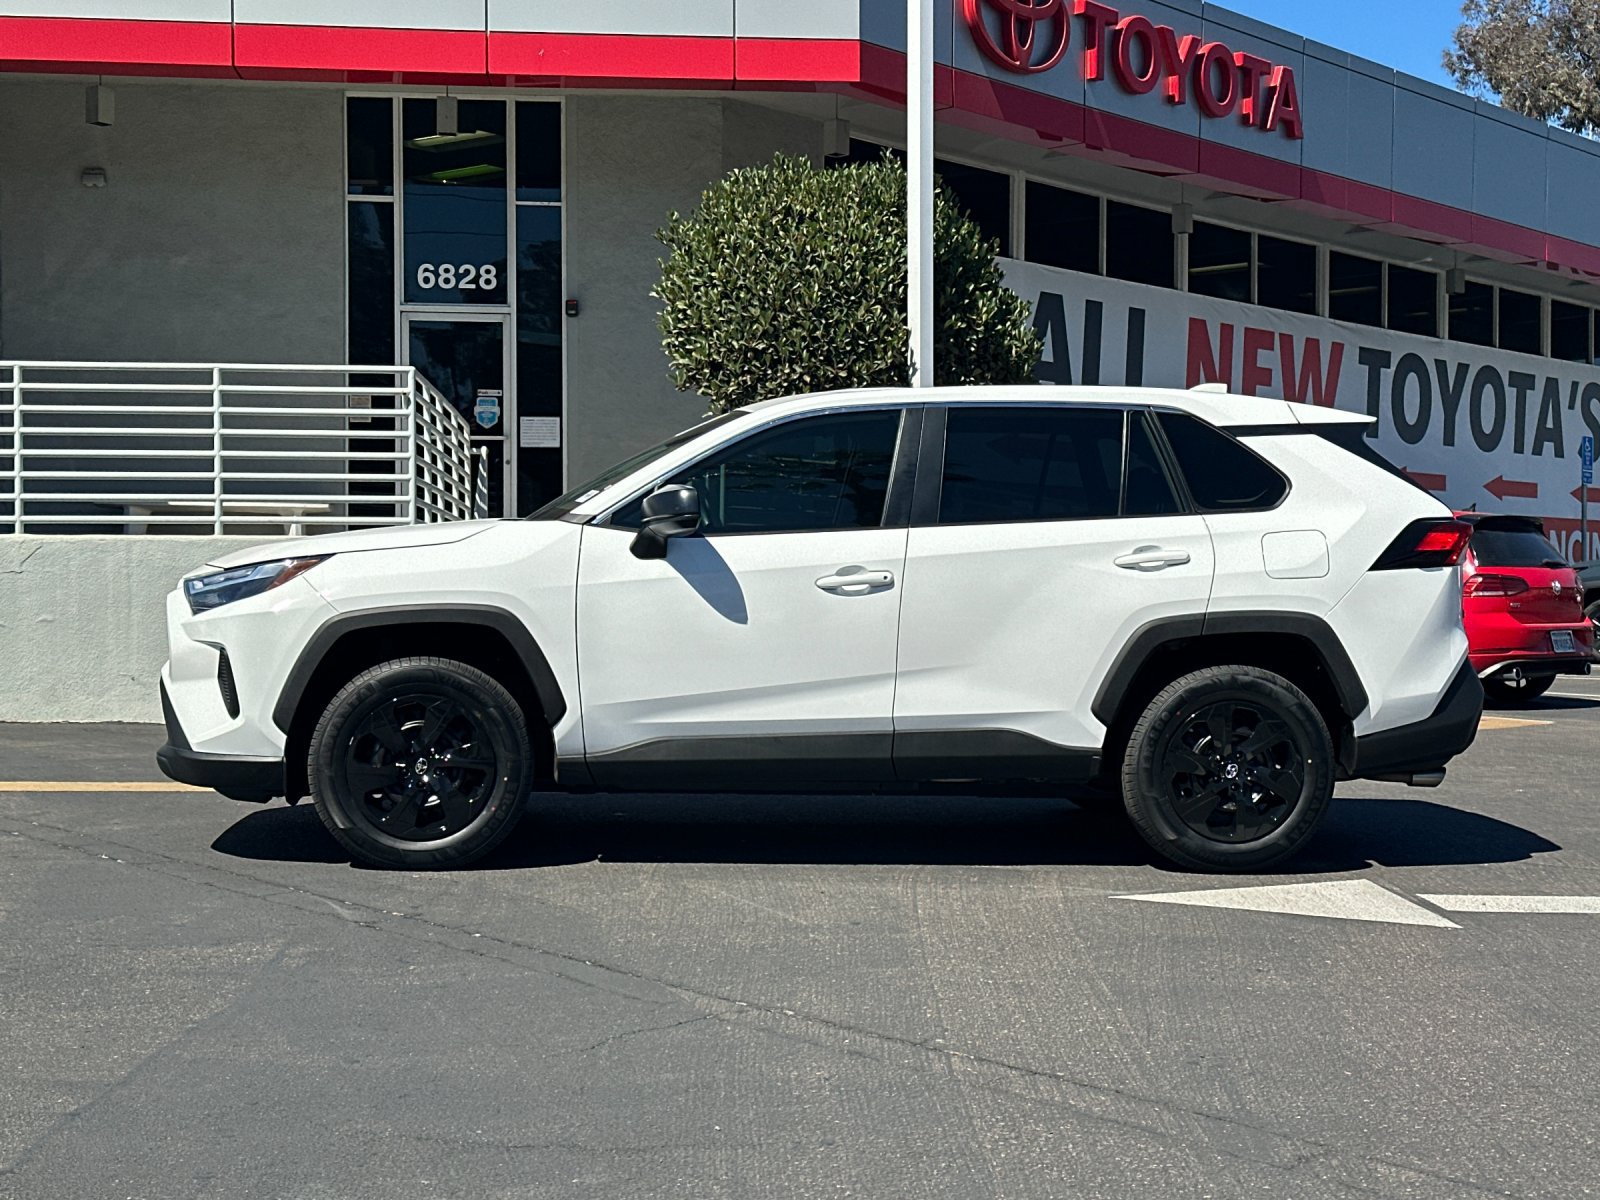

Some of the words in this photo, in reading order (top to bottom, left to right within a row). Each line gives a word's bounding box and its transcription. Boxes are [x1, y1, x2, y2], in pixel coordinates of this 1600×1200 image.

[1074, 0, 1303, 139] TOYOTA
[417, 263, 497, 290] 6828
[1186, 317, 1344, 408] NEW
